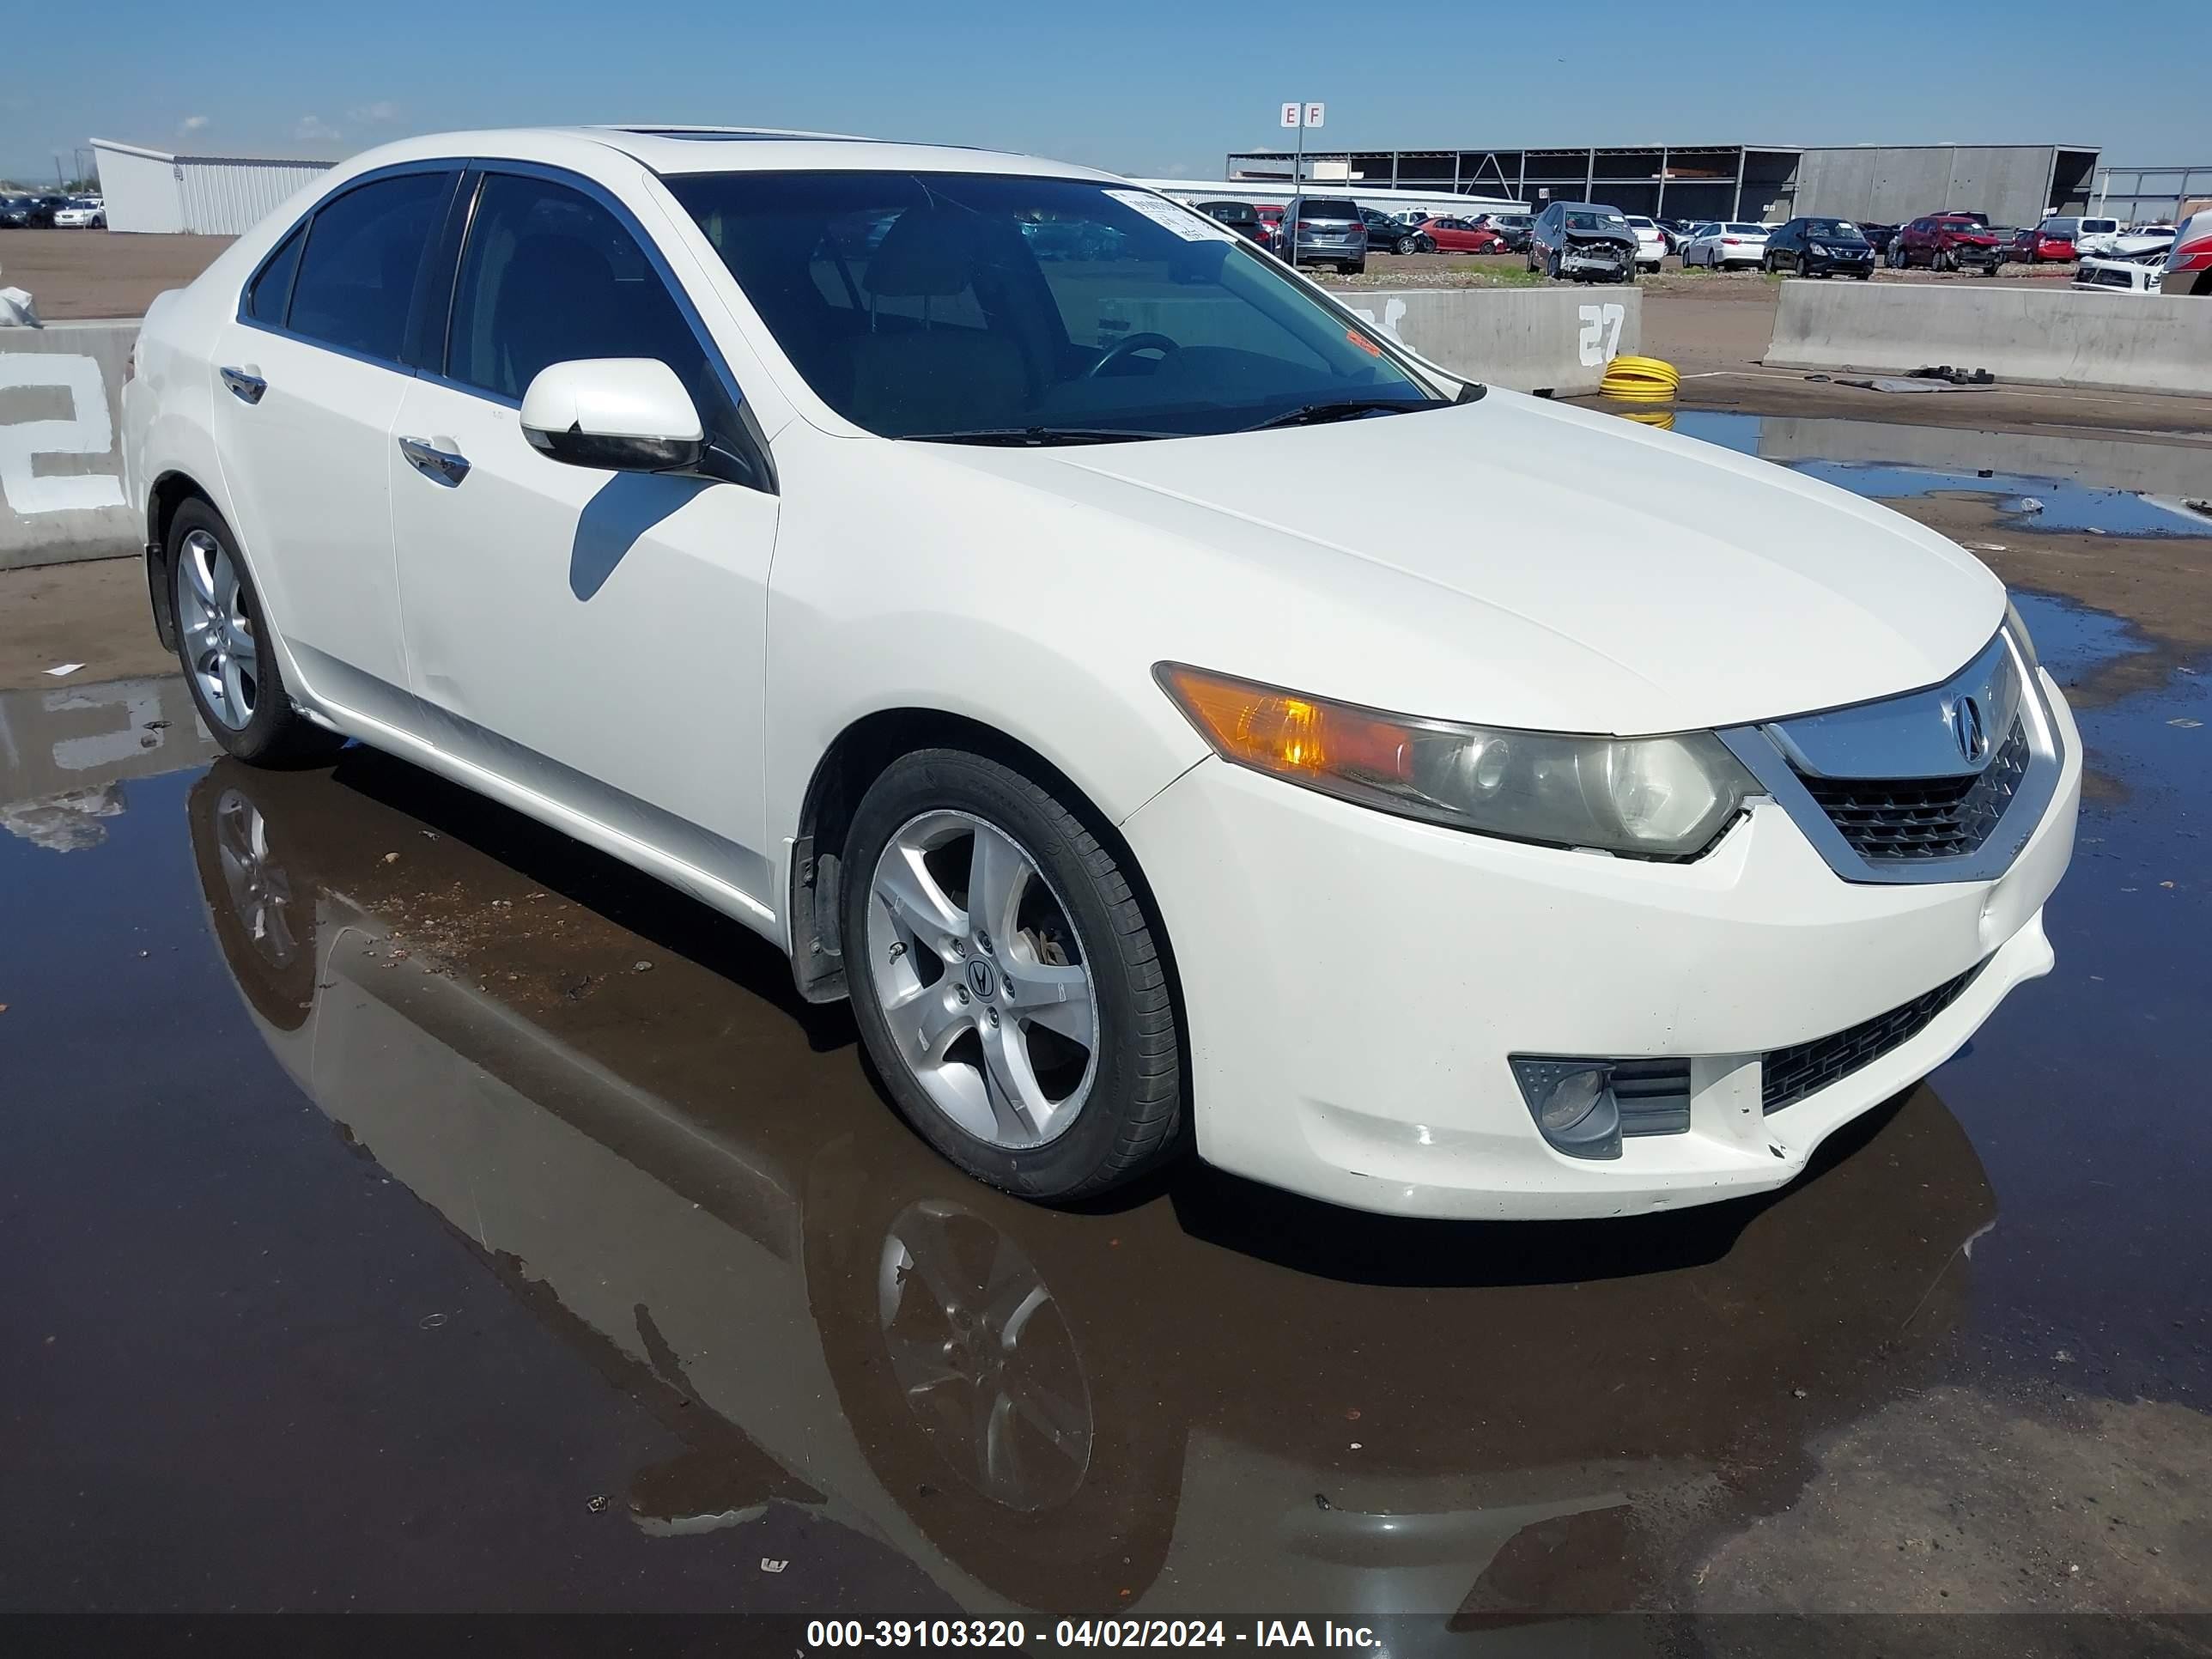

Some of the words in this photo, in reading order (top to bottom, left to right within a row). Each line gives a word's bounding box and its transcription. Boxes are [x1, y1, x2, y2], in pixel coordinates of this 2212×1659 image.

[1286, 107, 1296, 124] E
[1310, 107, 1320, 124] F
[1578, 303, 1626, 368] 27
[0, 352, 126, 515] 2
